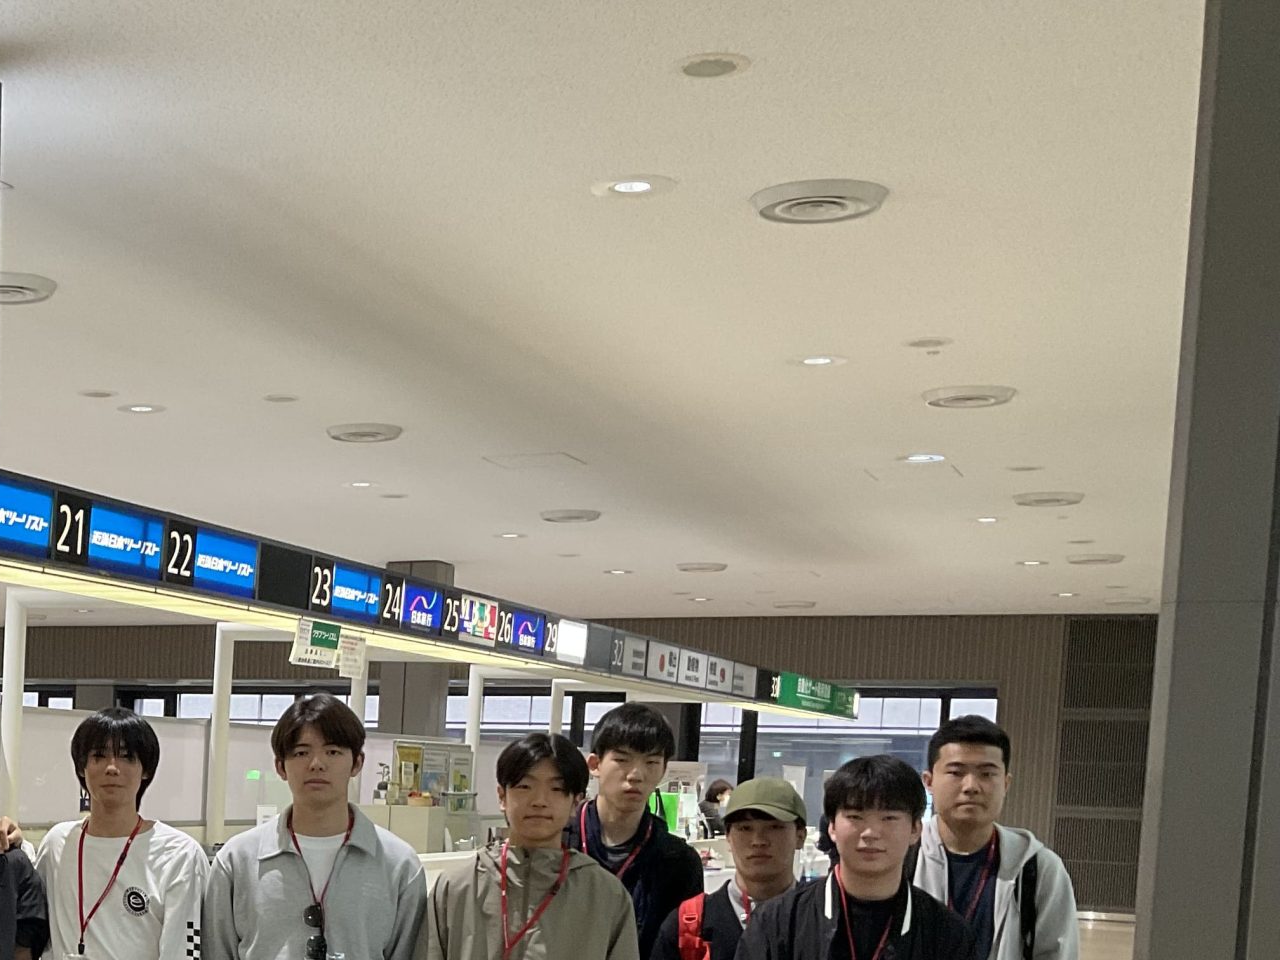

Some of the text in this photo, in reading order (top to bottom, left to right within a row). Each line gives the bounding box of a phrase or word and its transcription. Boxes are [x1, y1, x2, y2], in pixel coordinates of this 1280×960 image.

[56, 504, 85, 556] 21
[91, 530, 161, 556] 近畿日本ツーリスト
[167, 531, 194, 577] 22
[311, 566, 331, 607] 23
[383, 584, 402, 621] 24
[443, 598, 460, 632] 25
[498, 611, 512, 642] 26
[545, 622, 557, 653] 29
[612, 639, 624, 666] 32
